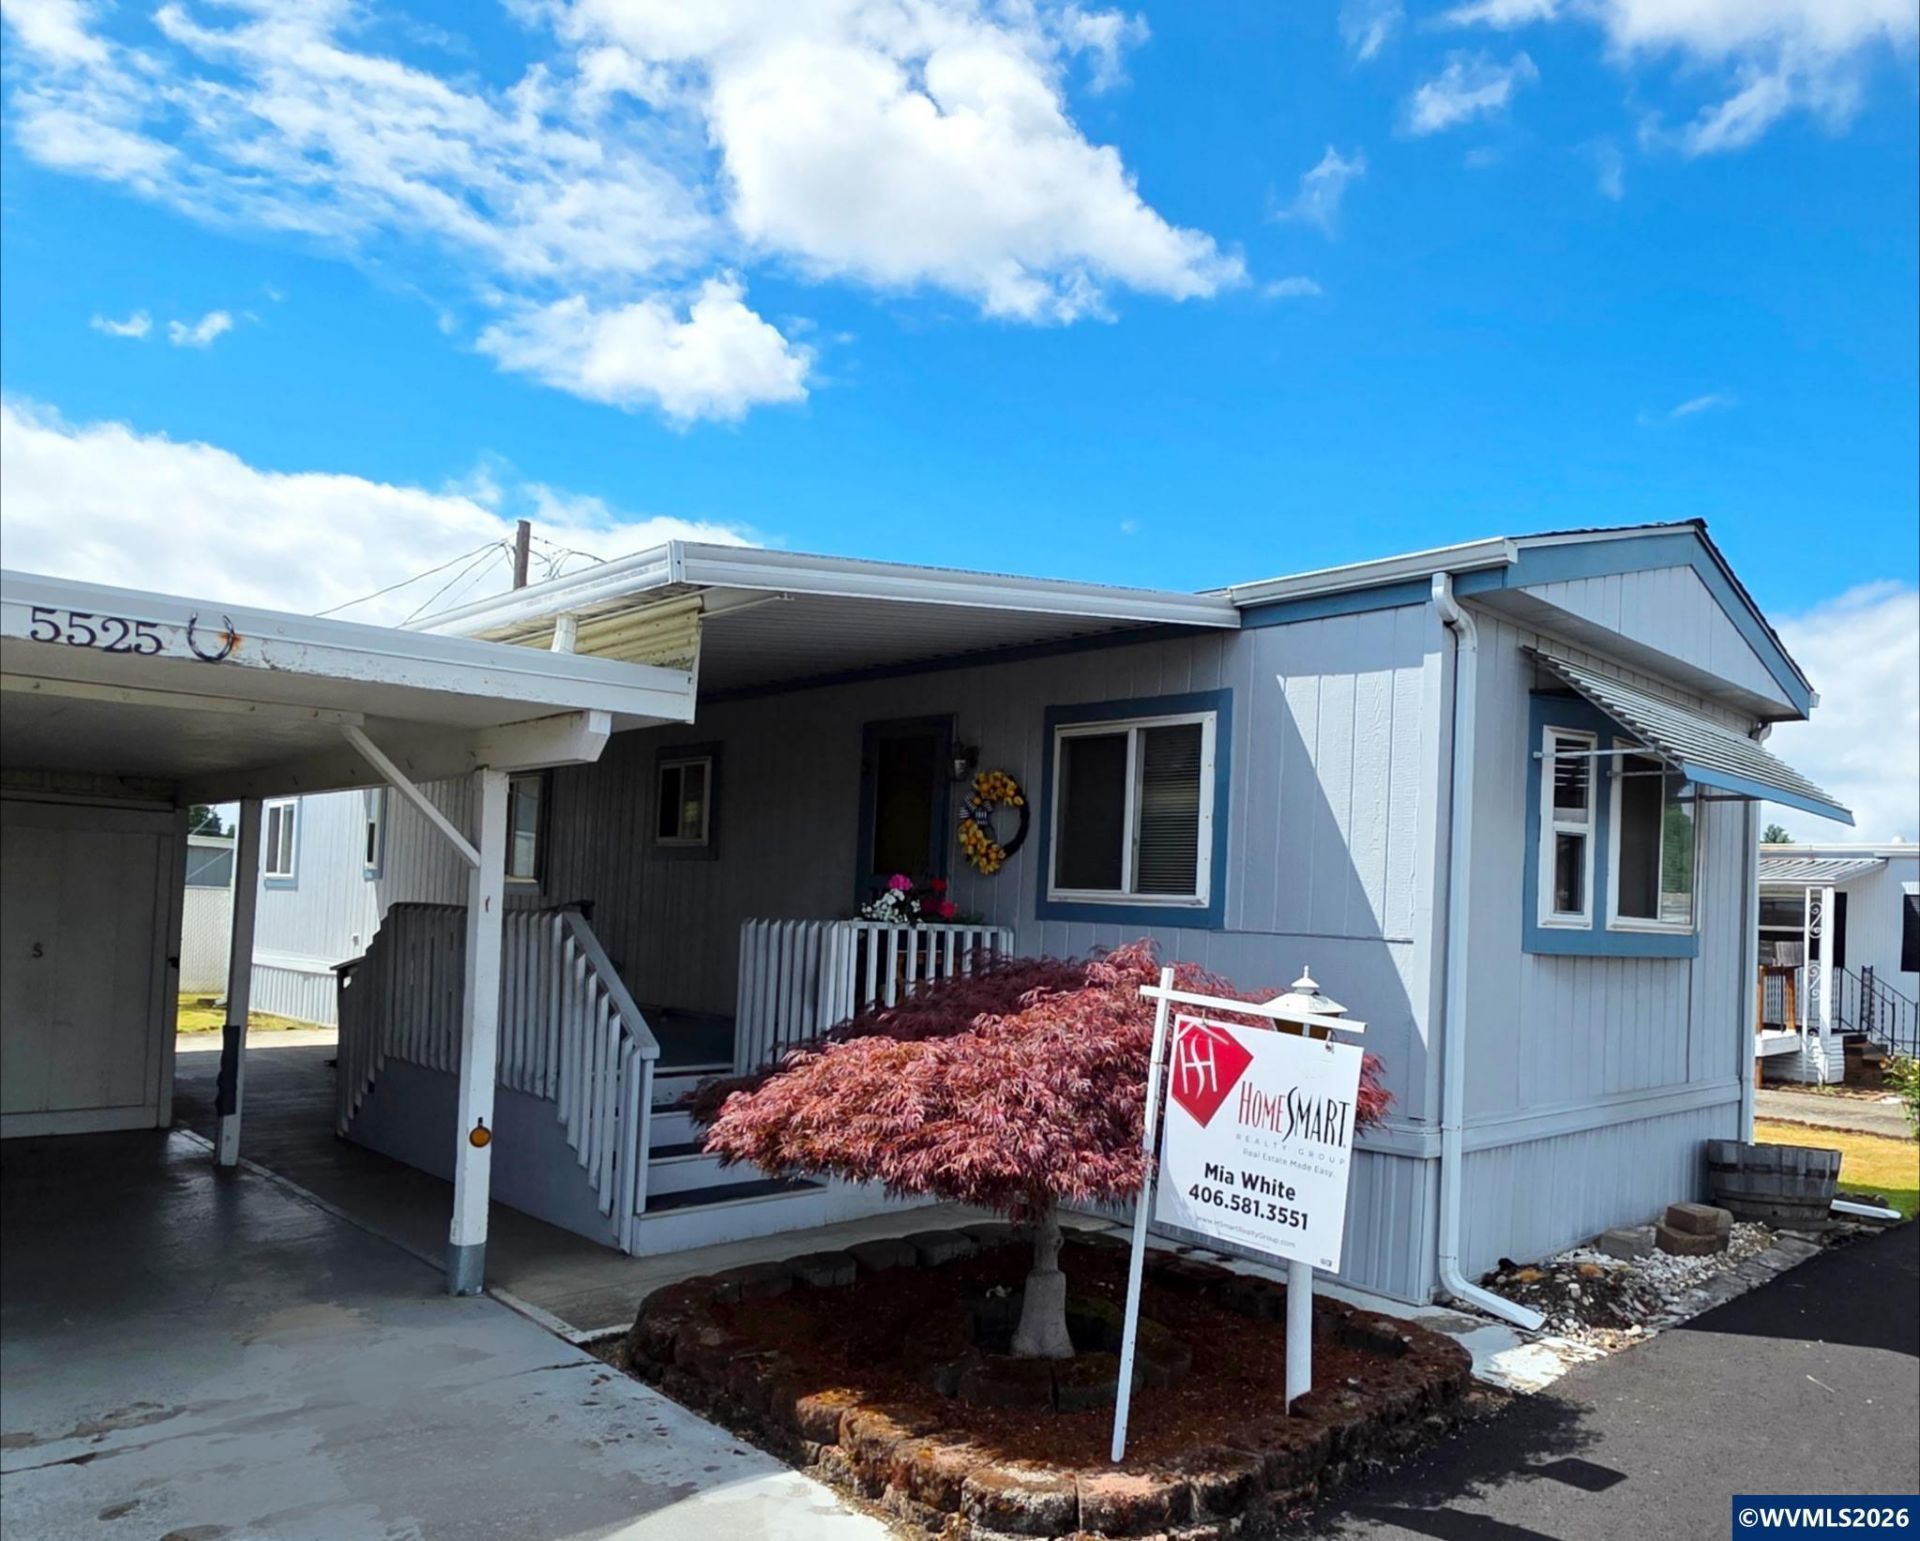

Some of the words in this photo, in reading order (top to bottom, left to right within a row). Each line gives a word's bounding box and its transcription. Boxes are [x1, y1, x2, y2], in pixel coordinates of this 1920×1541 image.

[30, 606, 163, 656] 5525
[1235, 1133, 1287, 1150] REALTY
[1297, 1148, 1345, 1165] GROUP
[1242, 1147, 1261, 1159] Real
[1262, 1152, 1288, 1165] Estate
[1289, 1159, 1312, 1171] Made
[1204, 1162, 1235, 1185] Mia
[1241, 1171, 1296, 1201] White
[1188, 1183, 1309, 1231] 406.581.3551
